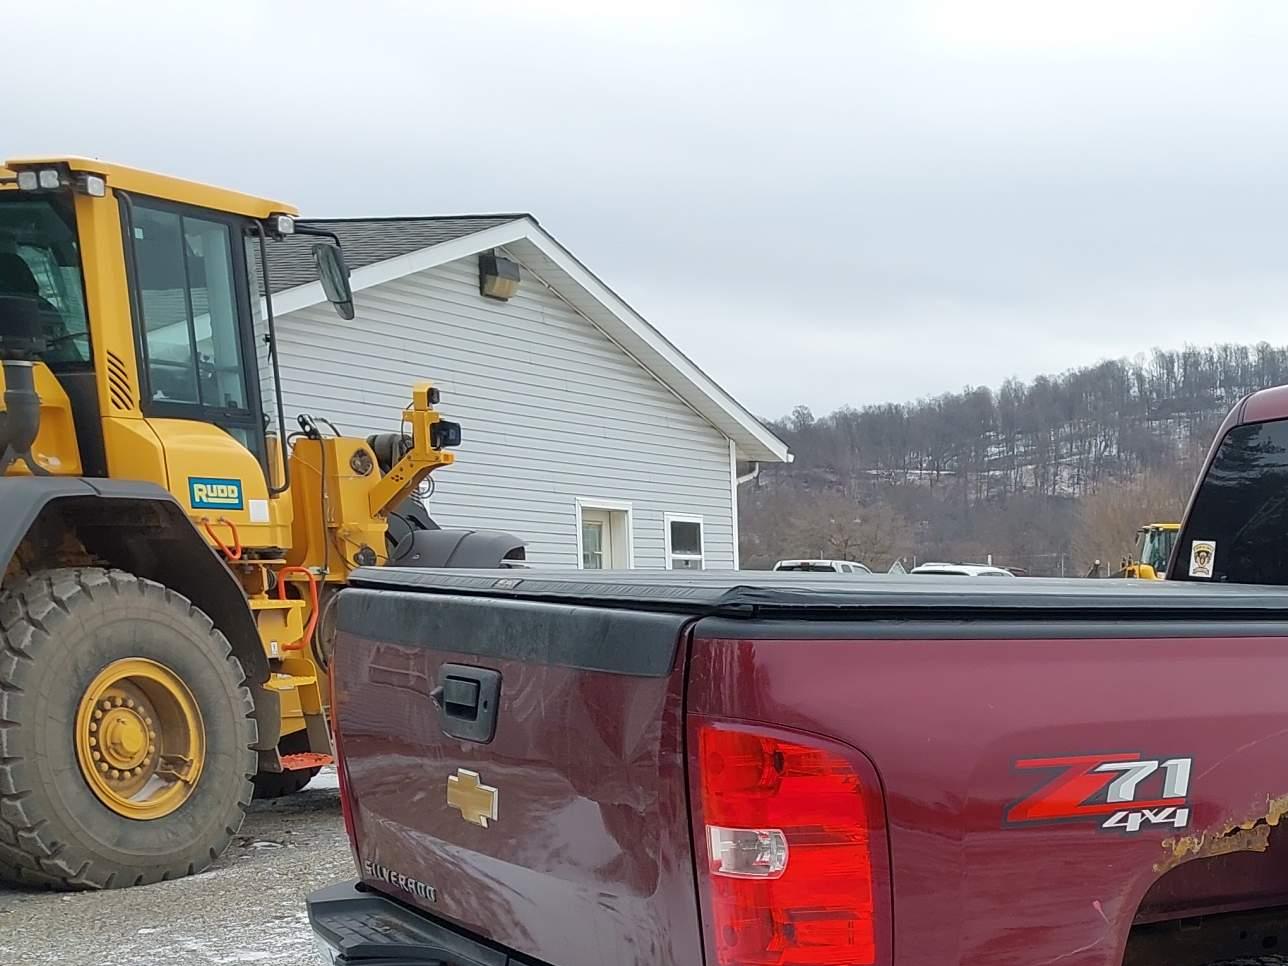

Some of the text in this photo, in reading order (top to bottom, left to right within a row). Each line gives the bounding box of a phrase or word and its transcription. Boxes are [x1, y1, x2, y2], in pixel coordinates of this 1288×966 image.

[193, 483, 238, 503] RUDD
[1006, 752, 1193, 822] Z71
[365, 860, 437, 902] SILVERADO
